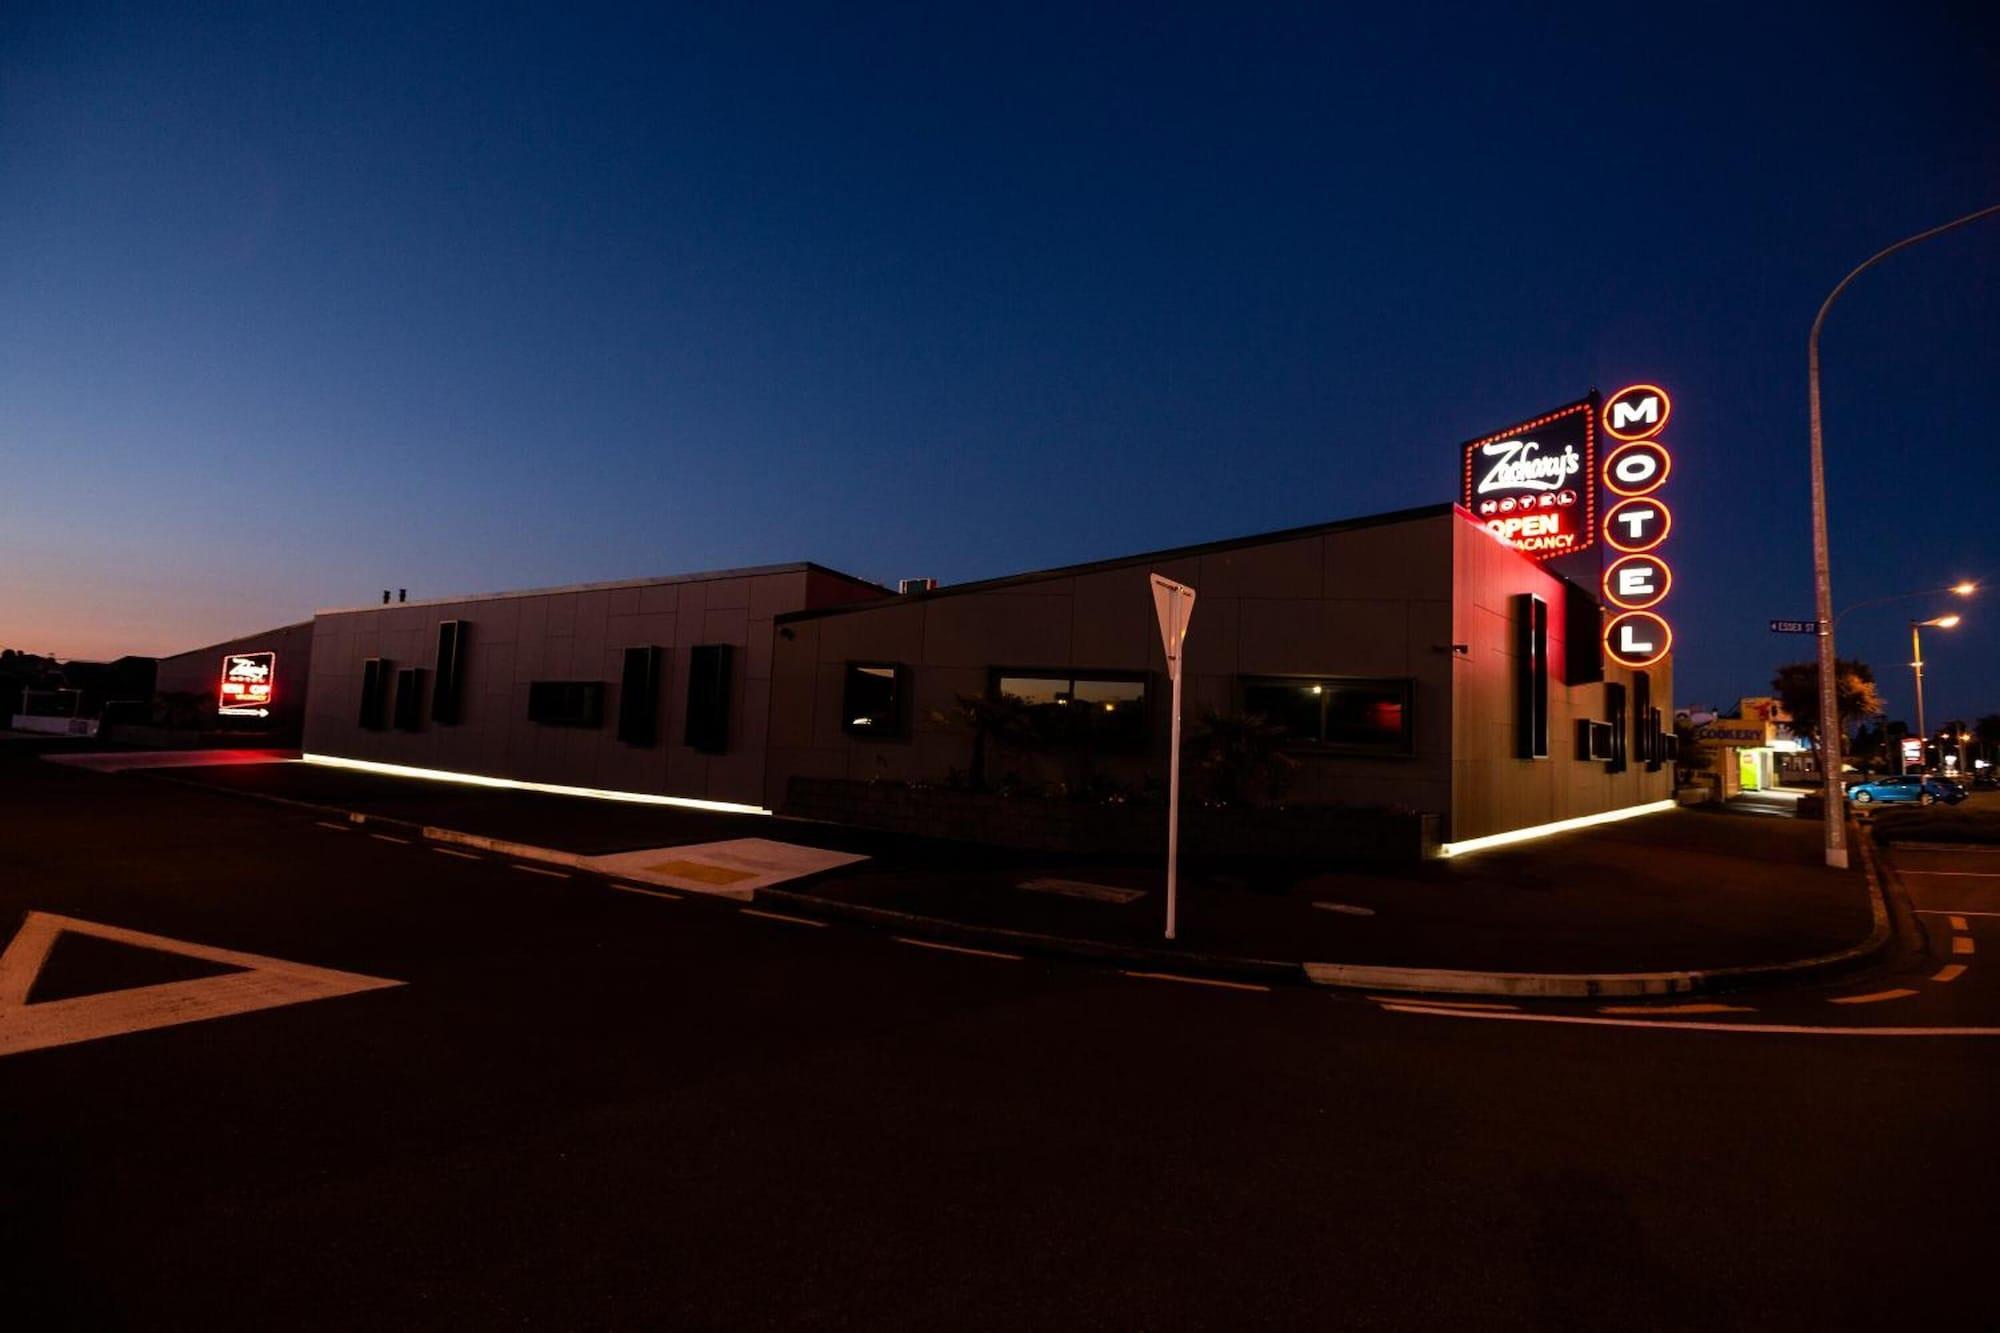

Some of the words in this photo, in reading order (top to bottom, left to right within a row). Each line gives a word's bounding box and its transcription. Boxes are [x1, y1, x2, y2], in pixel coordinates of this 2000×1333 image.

[1477, 441, 1580, 494] Zachary's
[1481, 491, 1575, 515] MOTEL
[1487, 513, 1559, 540] OPEN
[1613, 397, 1658, 653] MOTEL
[1512, 534, 1575, 551] ACANCY
